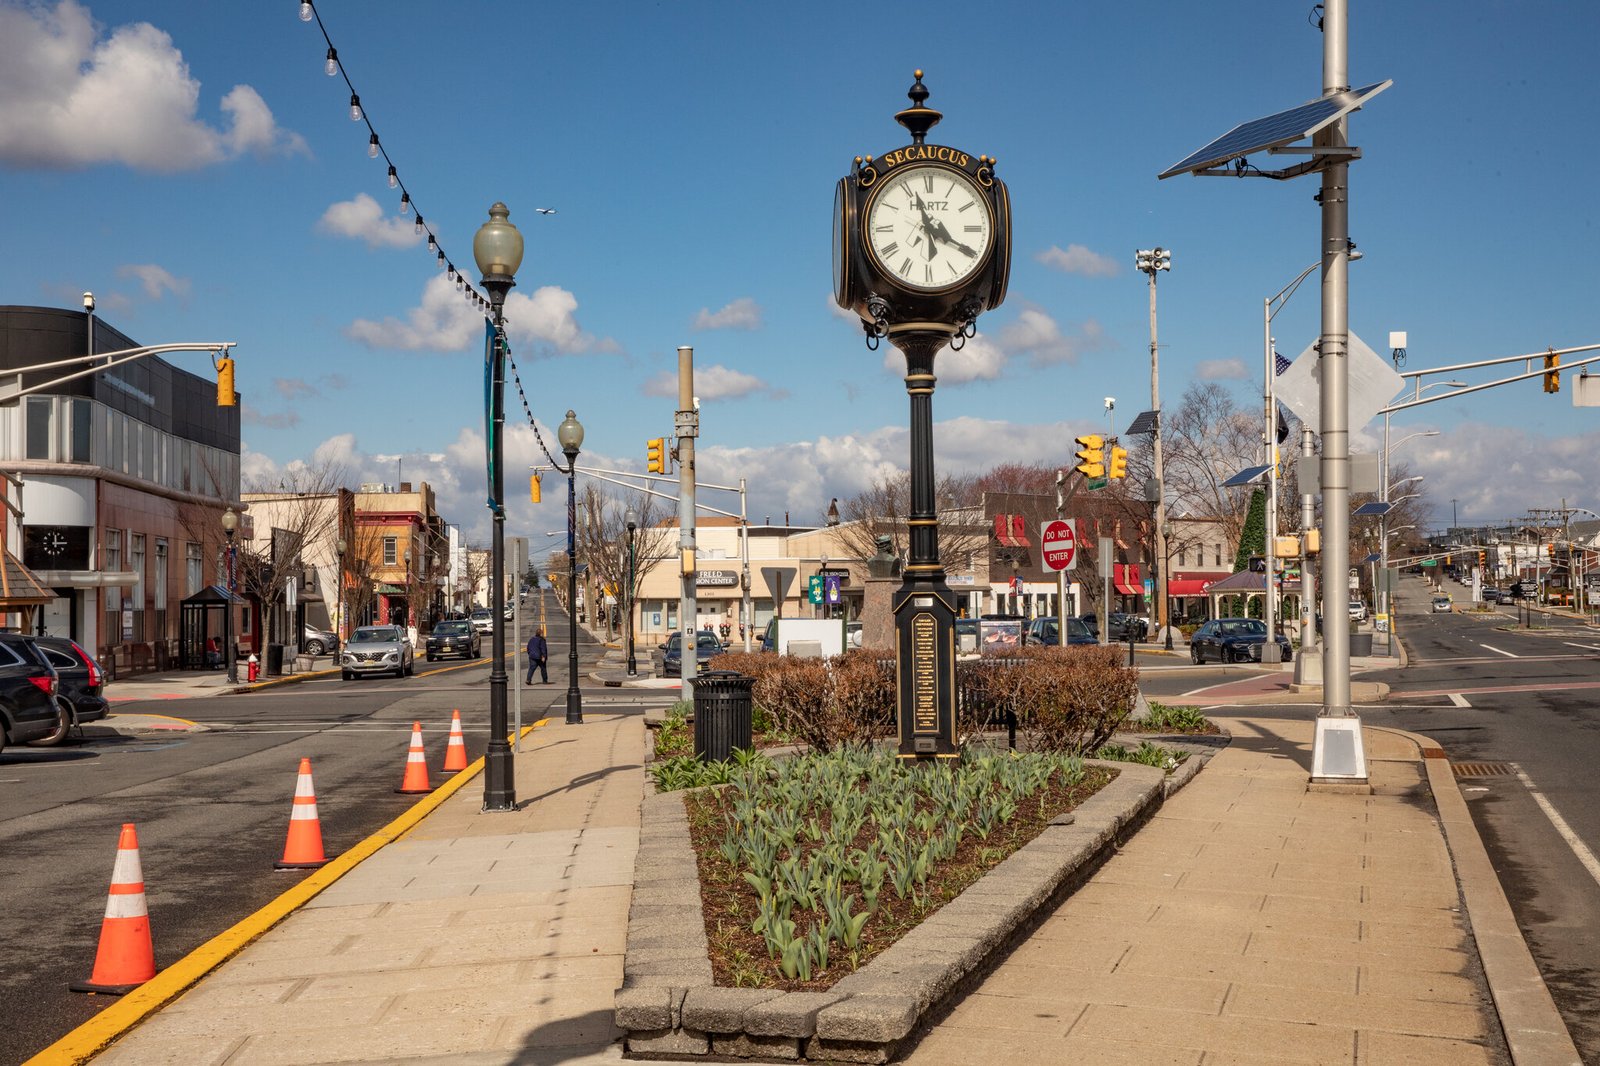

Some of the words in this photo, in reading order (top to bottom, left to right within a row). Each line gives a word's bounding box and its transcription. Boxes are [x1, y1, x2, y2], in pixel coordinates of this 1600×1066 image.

[885, 145, 969, 167] SECAUCUS
[909, 201, 949, 211] HARTZ
[1046, 531, 1055, 540] DO
[1058, 529, 1070, 539] NOT
[1049, 552, 1068, 562] ENTER
